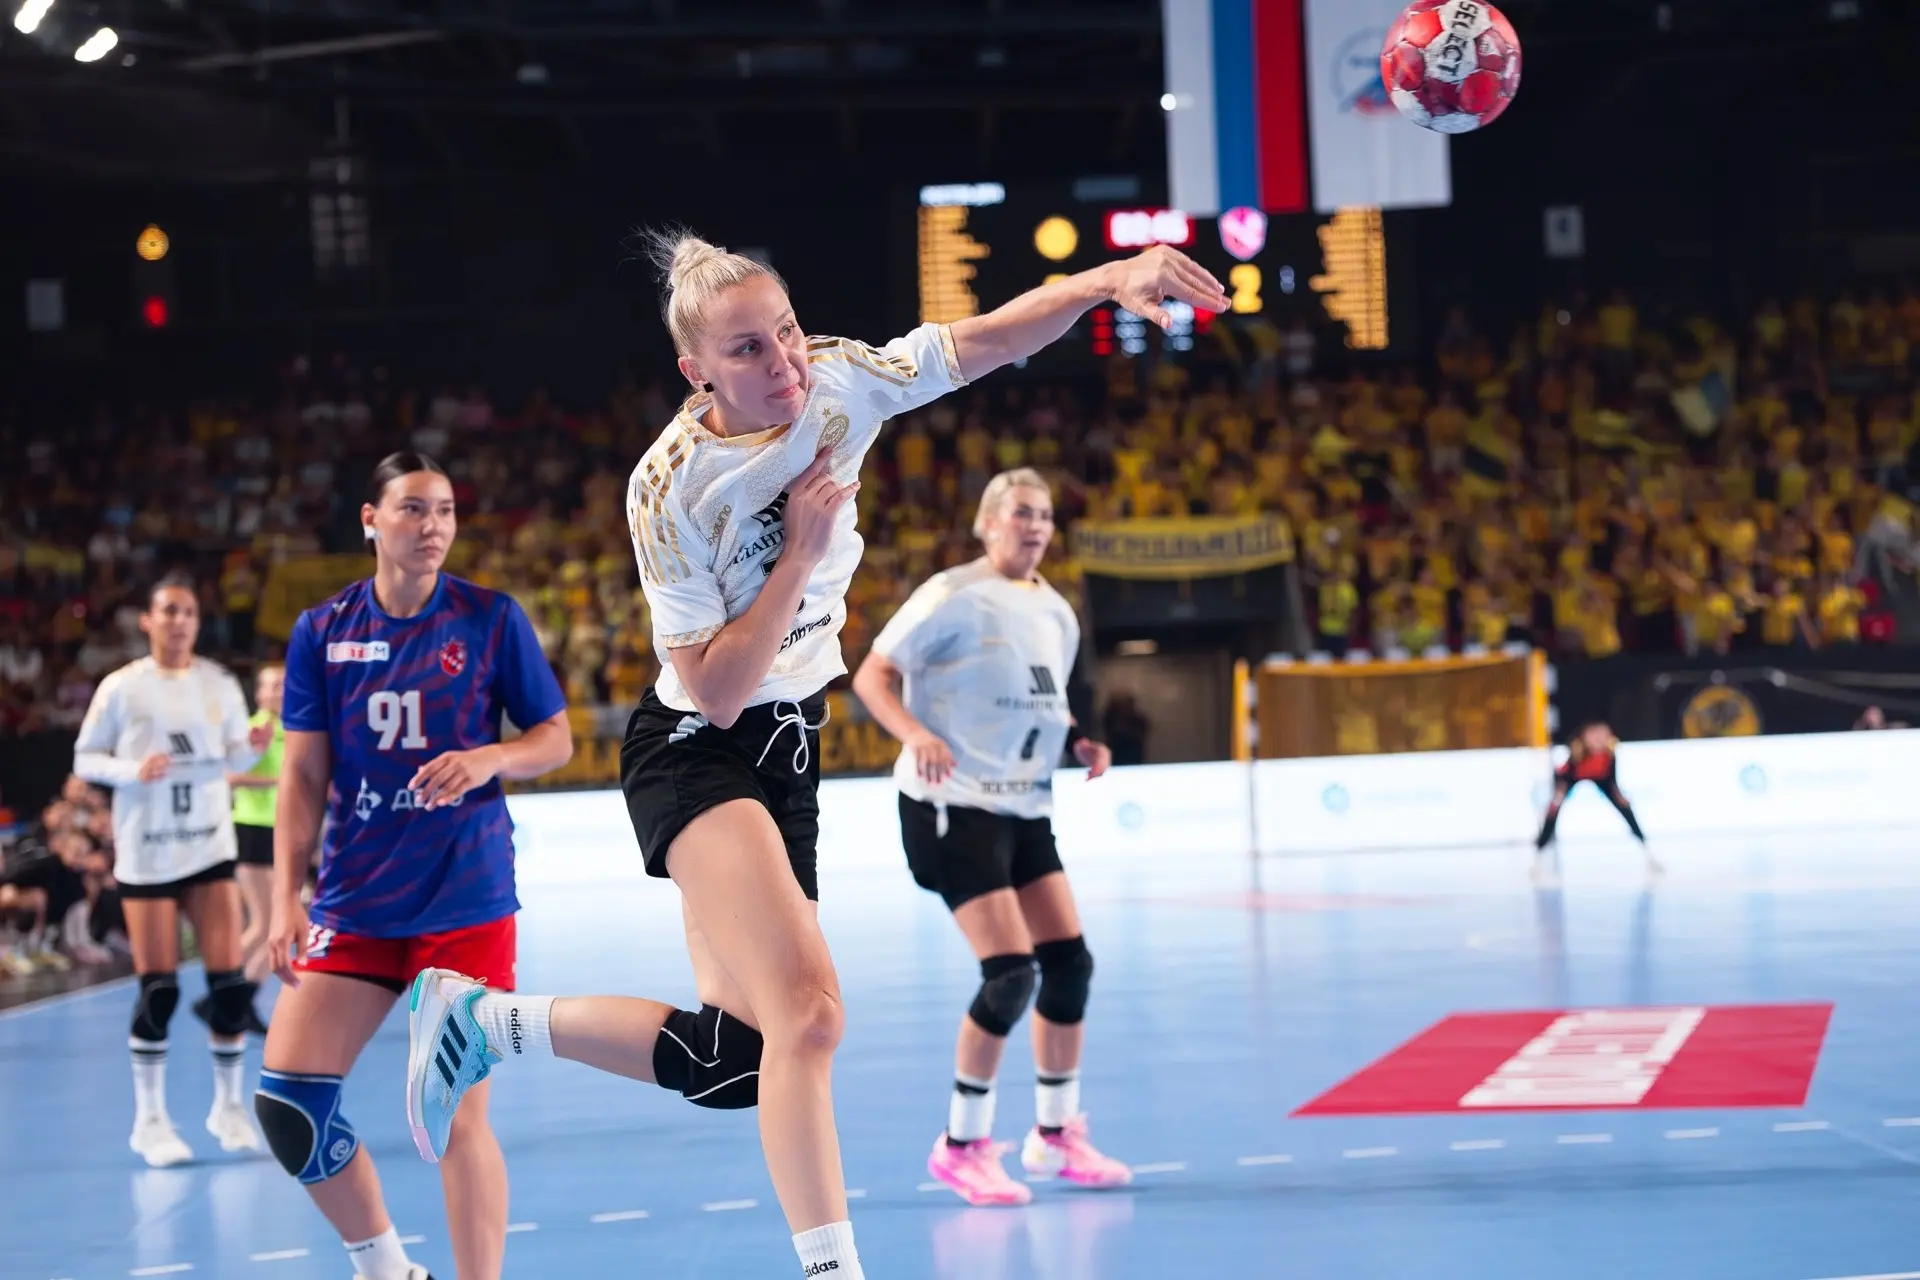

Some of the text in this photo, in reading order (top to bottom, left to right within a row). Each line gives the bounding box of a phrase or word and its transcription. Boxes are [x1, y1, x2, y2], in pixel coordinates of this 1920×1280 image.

[1437, 1, 1479, 77] SELECT
[1230, 264, 1263, 314] 2
[367, 690, 427, 750] 91
[510, 1008, 522, 1055] adidas
